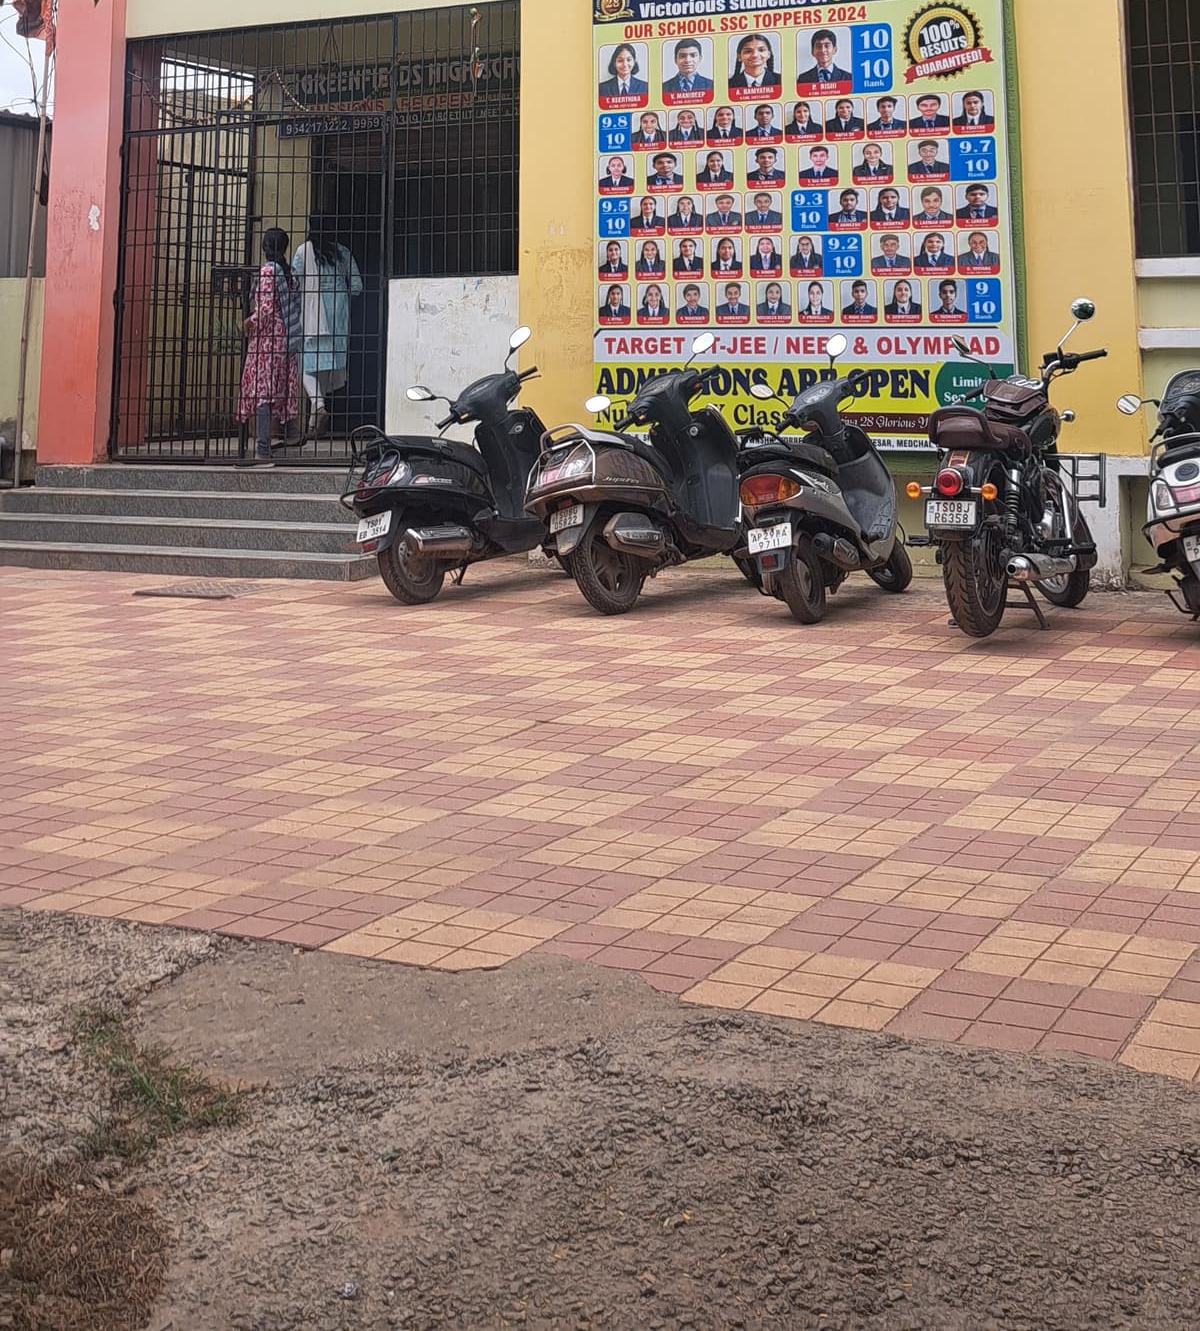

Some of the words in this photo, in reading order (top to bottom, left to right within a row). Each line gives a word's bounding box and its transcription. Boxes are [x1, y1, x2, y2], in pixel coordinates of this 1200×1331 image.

[624, 22, 653, 39] OUR
[658, 19, 715, 37] SCHOOL
[720, 16, 748, 32] SSC
[753, 10, 822, 29] TOPPERS
[827, 5, 867, 23] 2024
[860, 29, 889, 49] 10
[920, 20, 960, 45] 100%
[919, 35, 968, 59] RESULTS
[860, 59, 889, 79] 10
[915, 50, 983, 77] GUARANTEED!
[863, 80, 885, 88] Rank
[602, 115, 628, 128] 9.8
[606, 133, 625, 145] 10
[959, 140, 992, 153] 9.7
[965, 159, 989, 172] 10
[794, 193, 823, 205] 9.3
[602, 200, 628, 212] 9.5
[606, 218, 626, 229] 10
[800, 211, 820, 223] 10
[828, 237, 859, 250] 9.2
[833, 256, 856, 268] 10
[975, 281, 989, 295] 9
[971, 301, 996, 314] 10
[604, 337, 686, 355] TARGET
[852, 336, 869, 355] &
[847, 368, 930, 399] OPEN
[860, 416, 874, 427] 28
[876, 415, 916, 428] Glorious
[935, 501, 970, 513] TS08J
[934, 513, 969, 524] R6358
